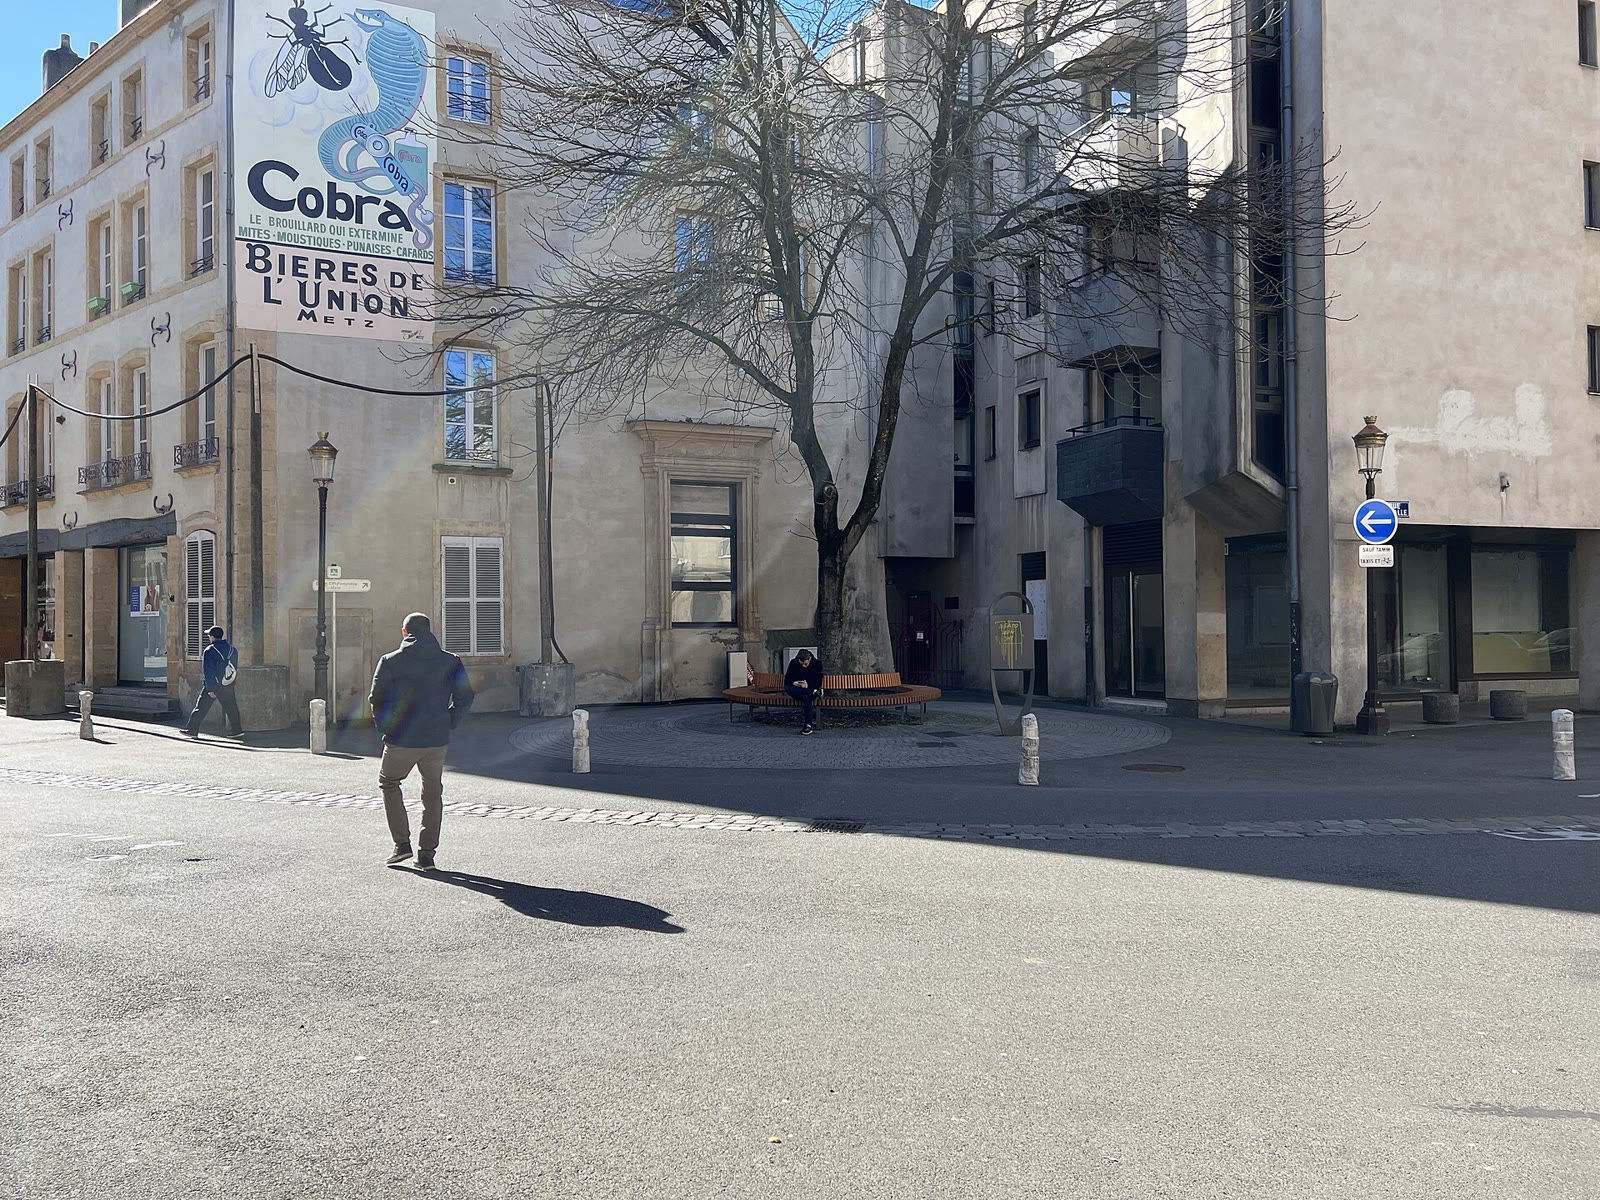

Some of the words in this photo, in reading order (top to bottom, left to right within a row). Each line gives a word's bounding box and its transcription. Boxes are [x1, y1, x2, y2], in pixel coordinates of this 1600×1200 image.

[383, 156, 409, 193] Cobra
[247, 160, 413, 232] Cobra
[238, 226, 271, 240] MITES
[277, 231, 341, 249] MOUSTIQUES
[347, 240, 392, 255] PUNAISES
[396, 246, 434, 260] CAFARDS
[249, 213, 262, 225] LE
[268, 216, 327, 233] BROUILLARD
[329, 224, 346, 237] QUI
[348, 227, 403, 244] EXTERMINE
[245, 243, 378, 286] BIERES
[389, 271, 424, 291] DE
[297, 309, 374, 328] METZ
